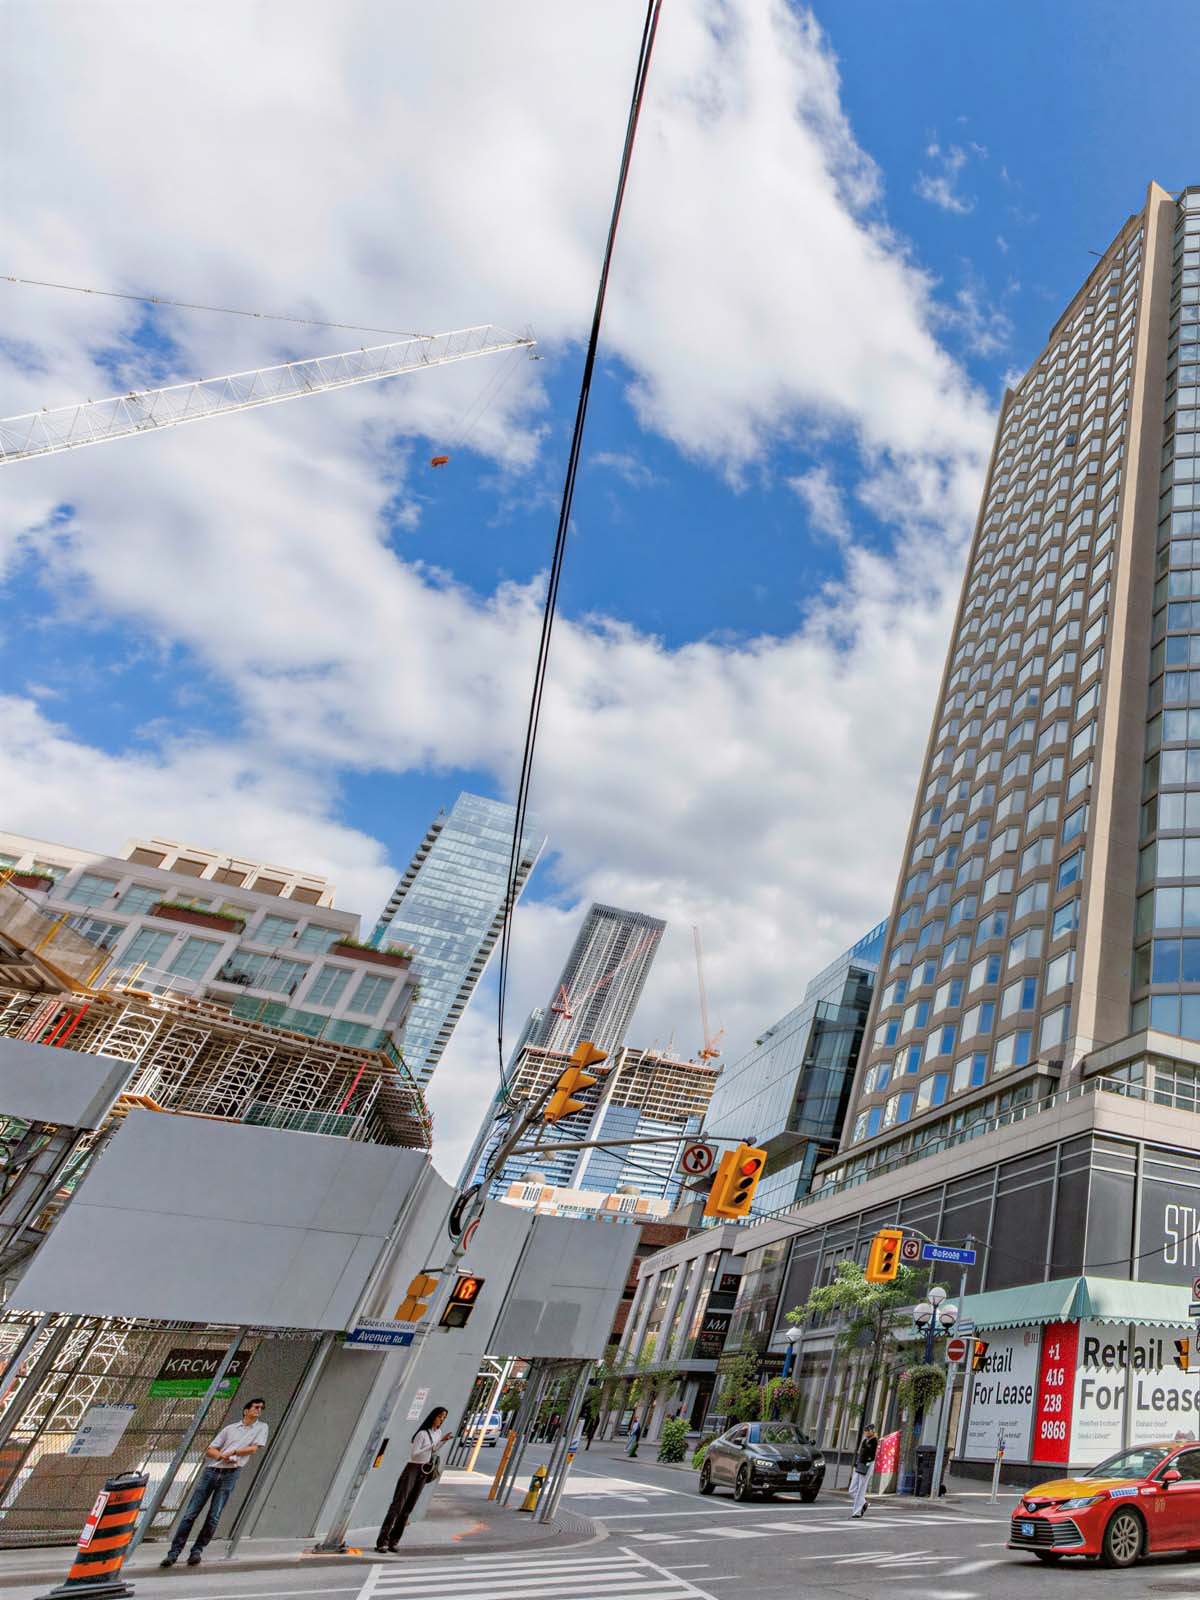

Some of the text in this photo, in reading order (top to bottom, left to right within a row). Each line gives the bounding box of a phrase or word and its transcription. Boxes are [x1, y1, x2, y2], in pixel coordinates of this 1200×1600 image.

[357, 1331, 403, 1343] Avenue Rd
[977, 1347, 1013, 1373] etail
[1048, 1343, 1060, 1360] +1
[1083, 1336, 1163, 1370] Retail
[165, 1359, 241, 1373] KRCMR
[1046, 1368, 1064, 1386] 416
[973, 1382, 1033, 1405] For Lease
[1043, 1394, 1062, 1412] 238
[1080, 1379, 1126, 1410] For
[1041, 1420, 1066, 1440] 9868
